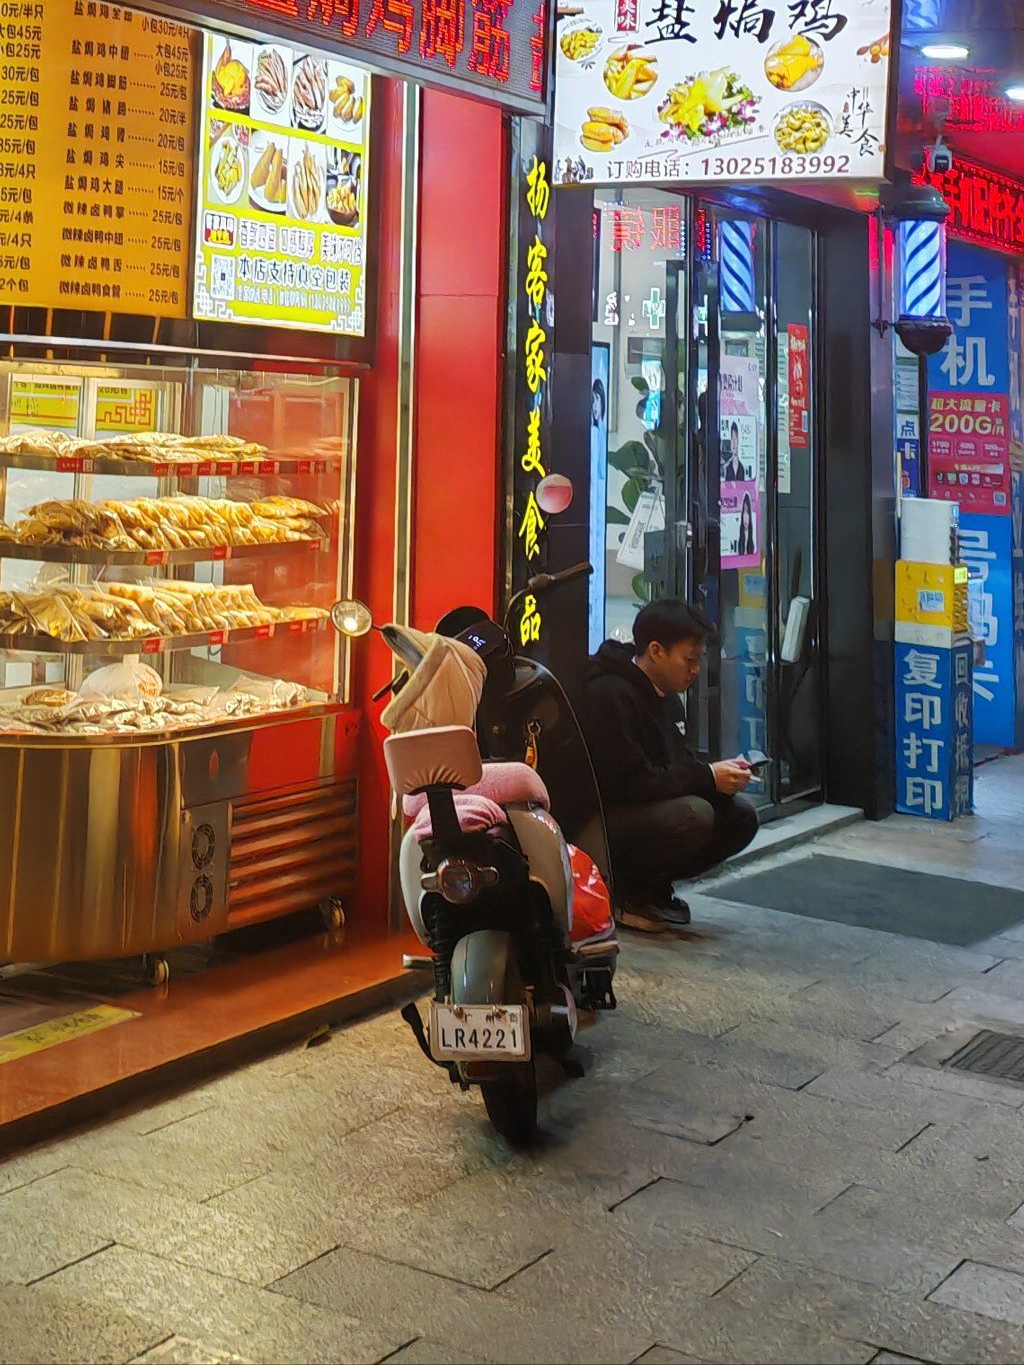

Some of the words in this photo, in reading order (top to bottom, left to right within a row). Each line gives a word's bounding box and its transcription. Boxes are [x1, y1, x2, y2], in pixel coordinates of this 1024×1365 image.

[156, 41, 189, 64] 大包45元
[1, 66, 40, 83] 30元/包
[155, 60, 188, 81] 小包25元
[1, 89, 39, 107] 25元/包
[160, 82, 187, 101] 25元/包
[0, 113, 38, 131] 25元/包
[158, 133, 185, 152] 20元/包
[158, 158, 185, 177] 15元/包
[700, 154, 851, 177] 13025183992
[157, 185, 184, 204] 15元/个
[152, 209, 183, 226] 25元/包
[151, 235, 182, 253] 25元/包
[150, 262, 180, 279] 25元/包
[239, 256, 351, 293] 本店支持真空包装
[148, 289, 179, 305] 25元/包
[939, 275, 996, 387] 手机
[902, 647, 944, 816] 复印打印
[441, 1028, 518, 1049] LR4221
